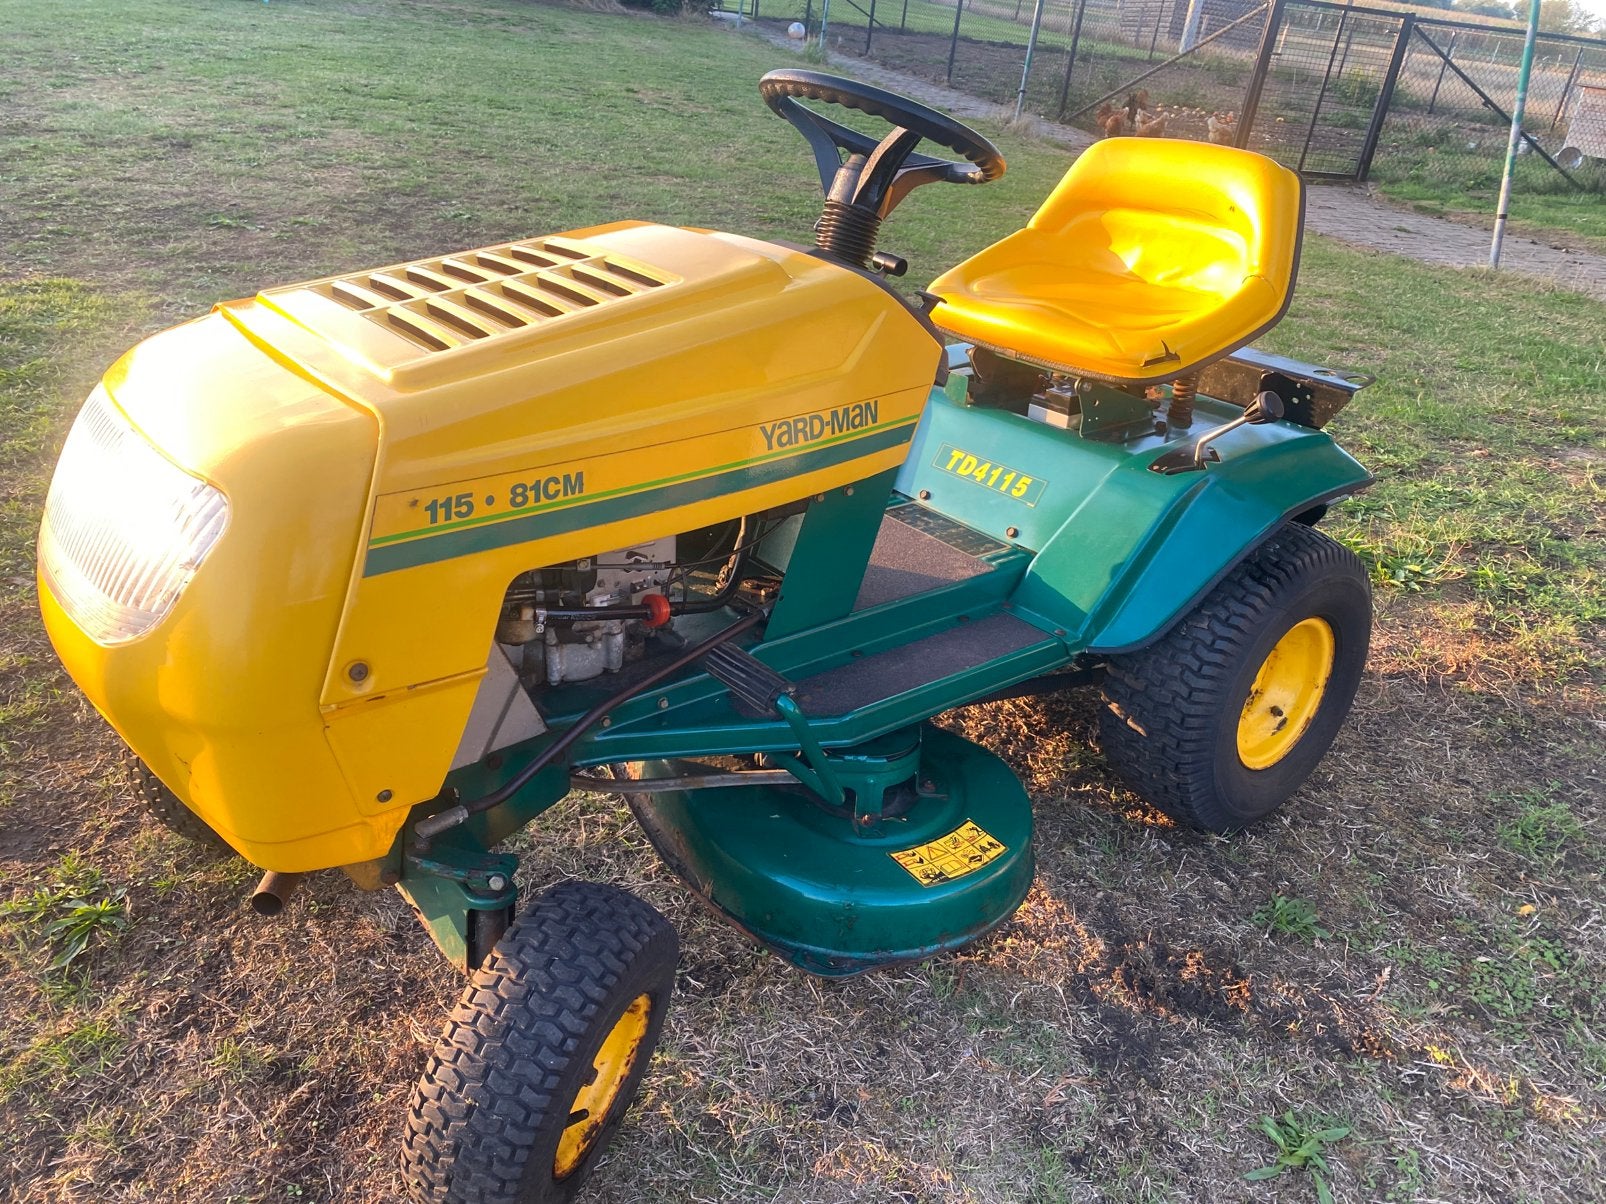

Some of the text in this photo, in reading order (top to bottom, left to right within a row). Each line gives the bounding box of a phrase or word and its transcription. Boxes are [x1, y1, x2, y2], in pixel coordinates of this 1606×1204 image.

[425, 471, 584, 524] 115 81CM
[945, 450, 1033, 497] TD4115
